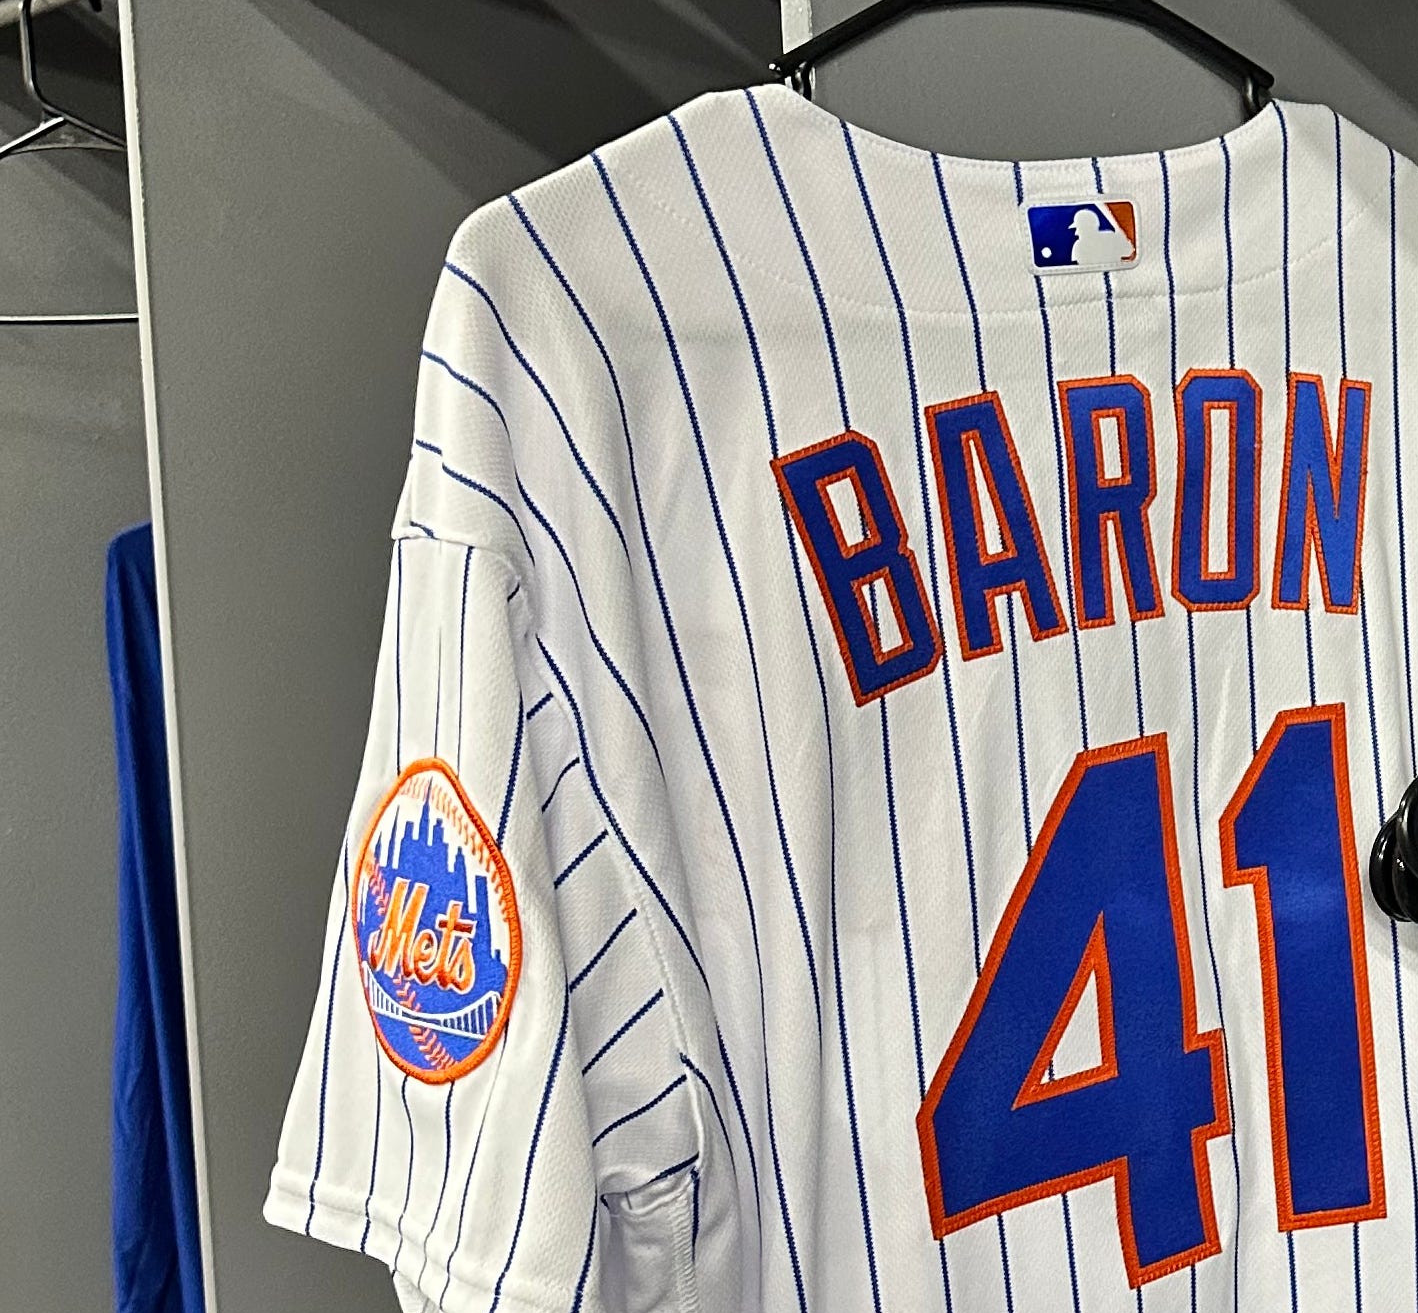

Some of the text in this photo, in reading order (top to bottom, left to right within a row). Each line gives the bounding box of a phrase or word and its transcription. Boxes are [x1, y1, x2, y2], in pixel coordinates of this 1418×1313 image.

[770, 368, 1372, 707] BARON
[367, 877, 477, 995] Mets
[916, 702, 1387, 1289] 41
